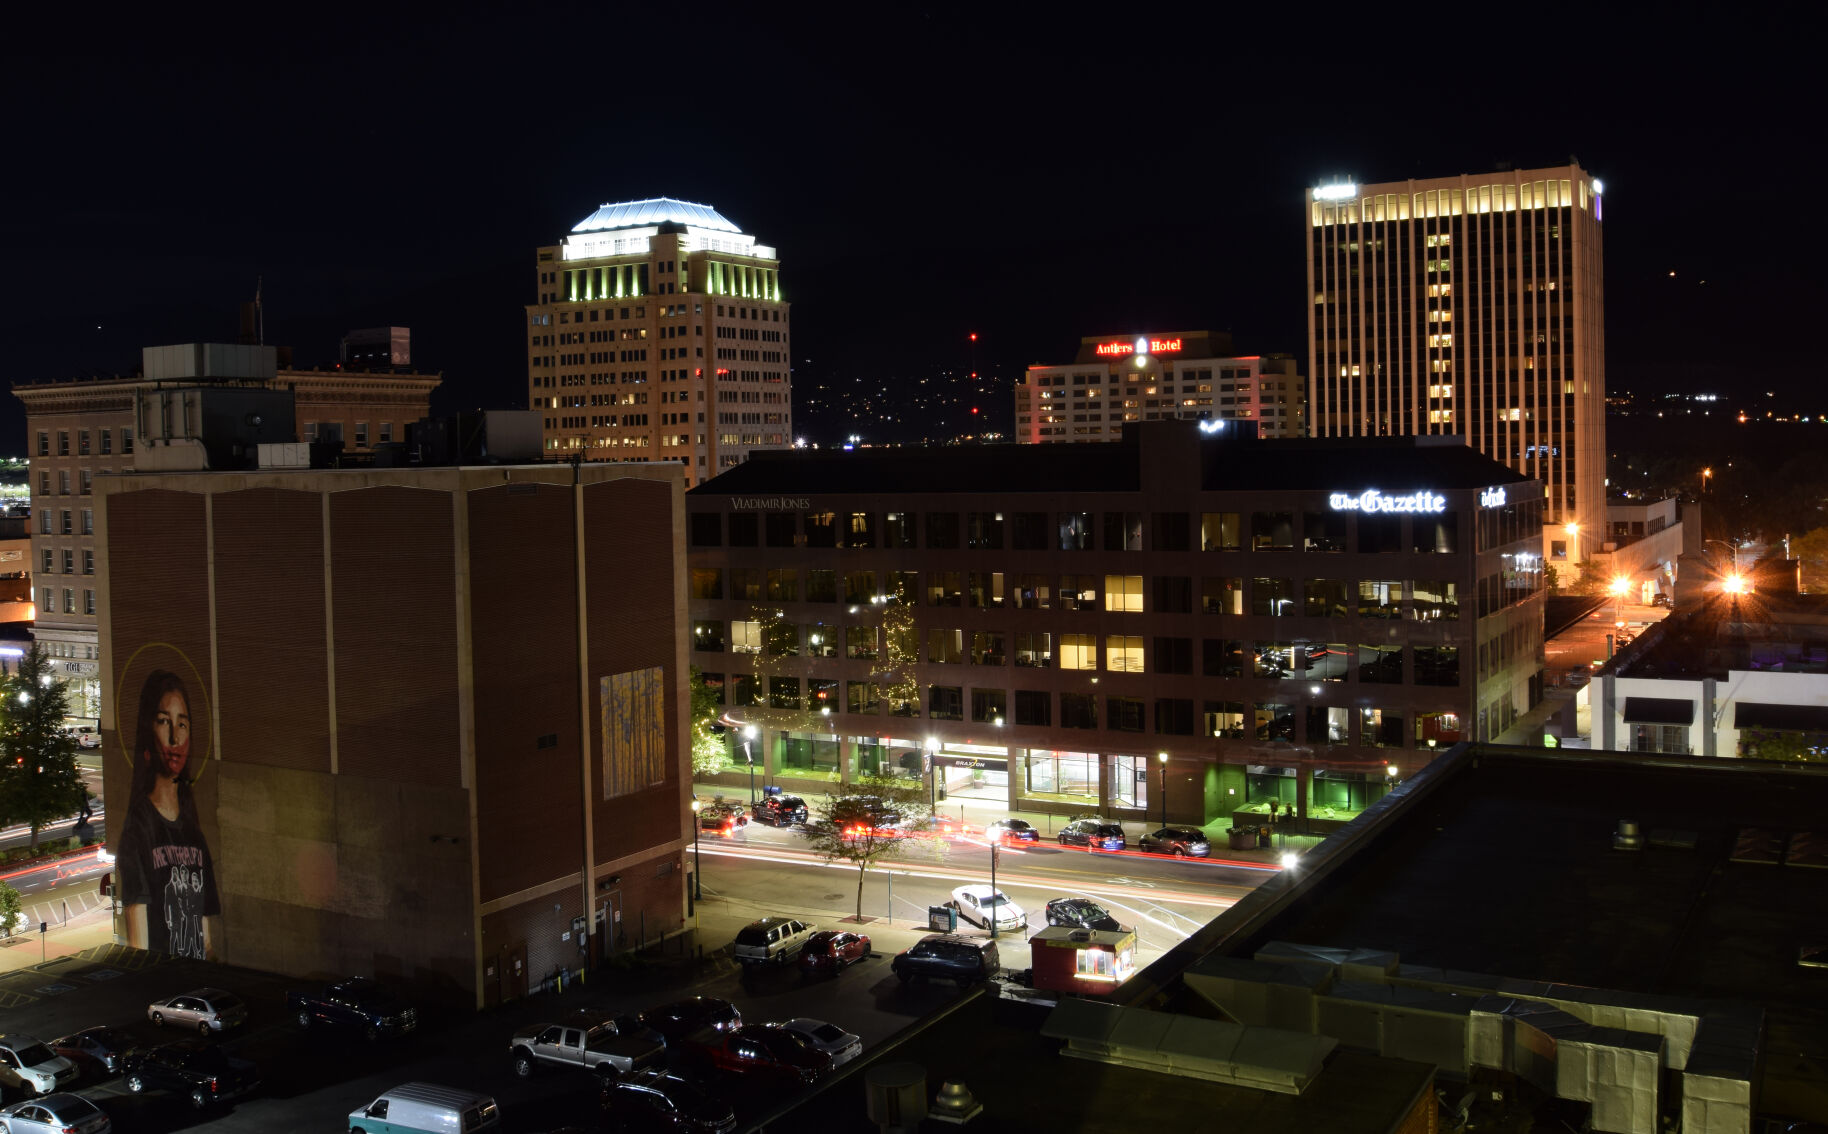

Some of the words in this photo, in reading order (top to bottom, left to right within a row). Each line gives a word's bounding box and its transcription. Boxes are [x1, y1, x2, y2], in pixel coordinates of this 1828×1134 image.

[1096, 343, 1133, 355] Antlers
[1151, 338, 1181, 352] Hotel
[731, 497, 780, 511] VLADIMIR
[780, 497, 810, 511] JONES
[1329, 493, 1359, 510] The
[1359, 489, 1446, 513] Gazette
